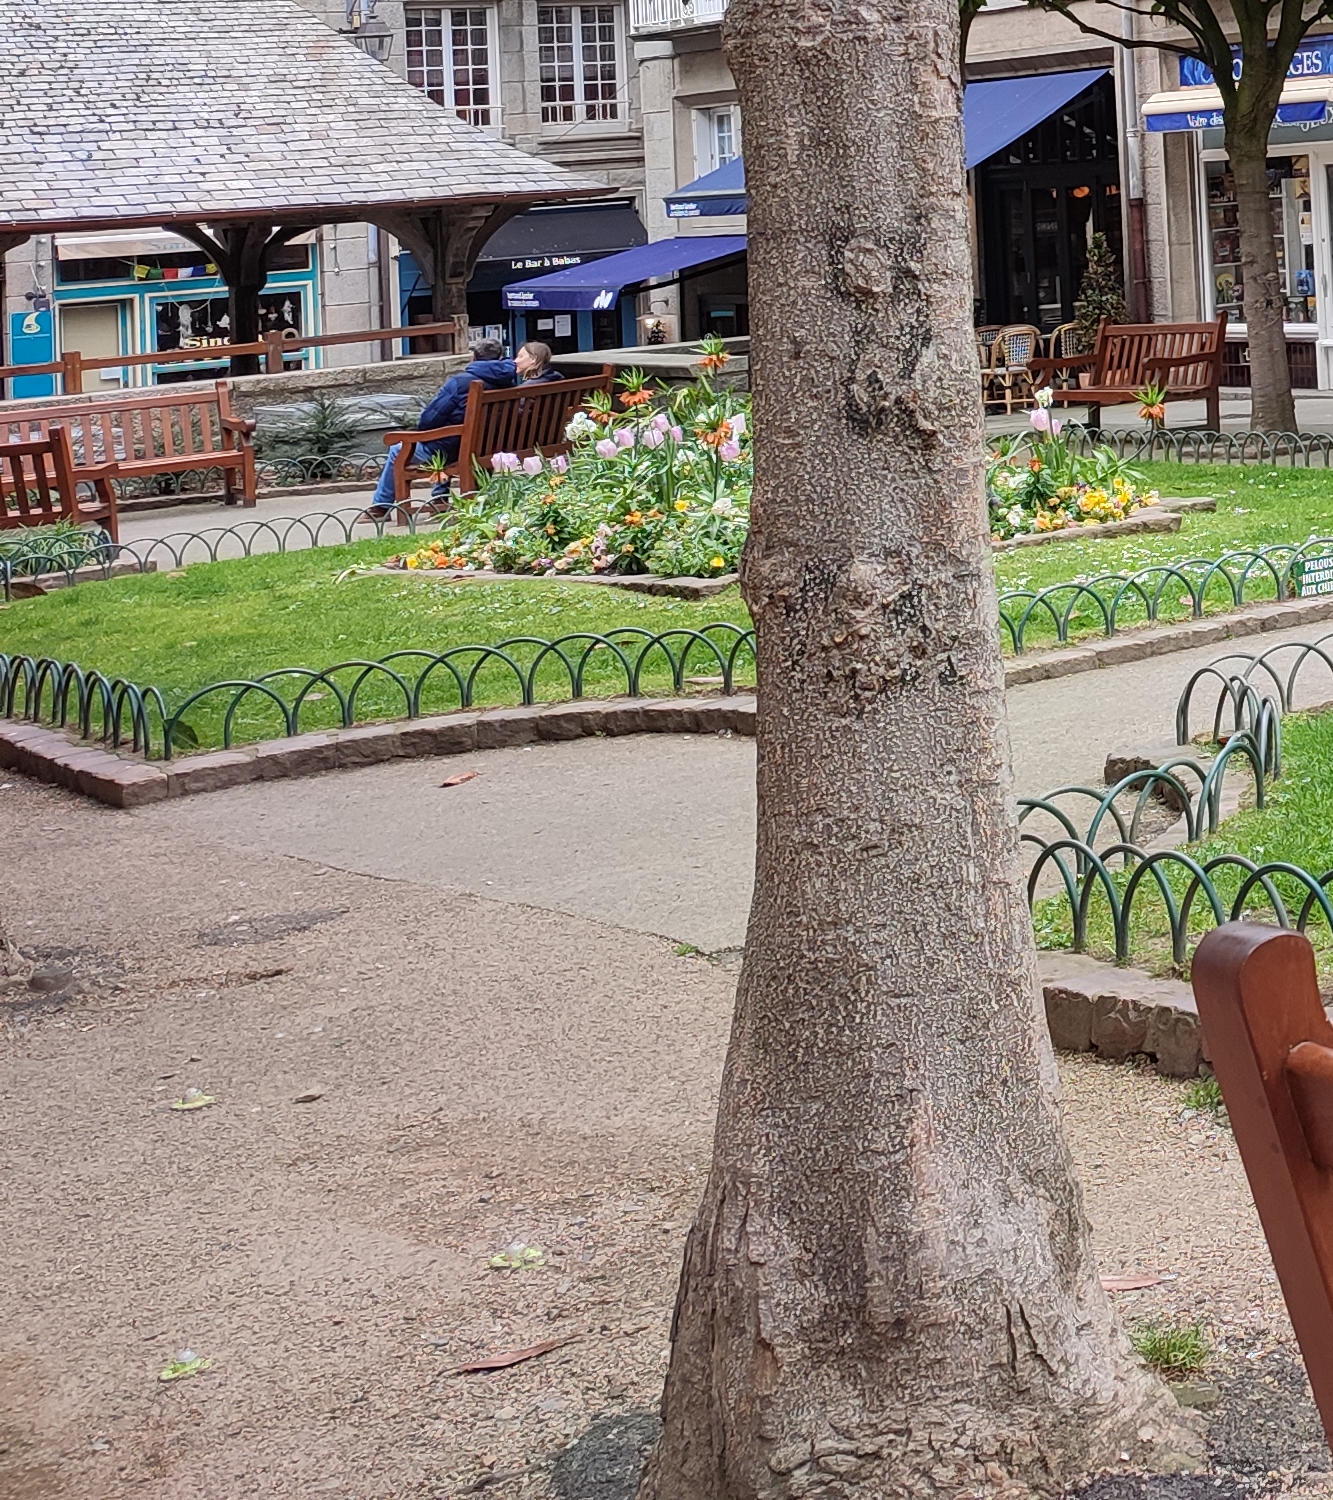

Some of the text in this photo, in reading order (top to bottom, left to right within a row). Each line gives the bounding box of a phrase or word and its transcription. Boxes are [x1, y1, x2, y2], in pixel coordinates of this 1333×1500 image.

[1186, 113, 1207, 127] Votre
[512, 260, 523, 269] Le
[525, 259, 542, 268] Bar
[552, 256, 581, 266] Babas
[1301, 584, 1317, 597] AUX
